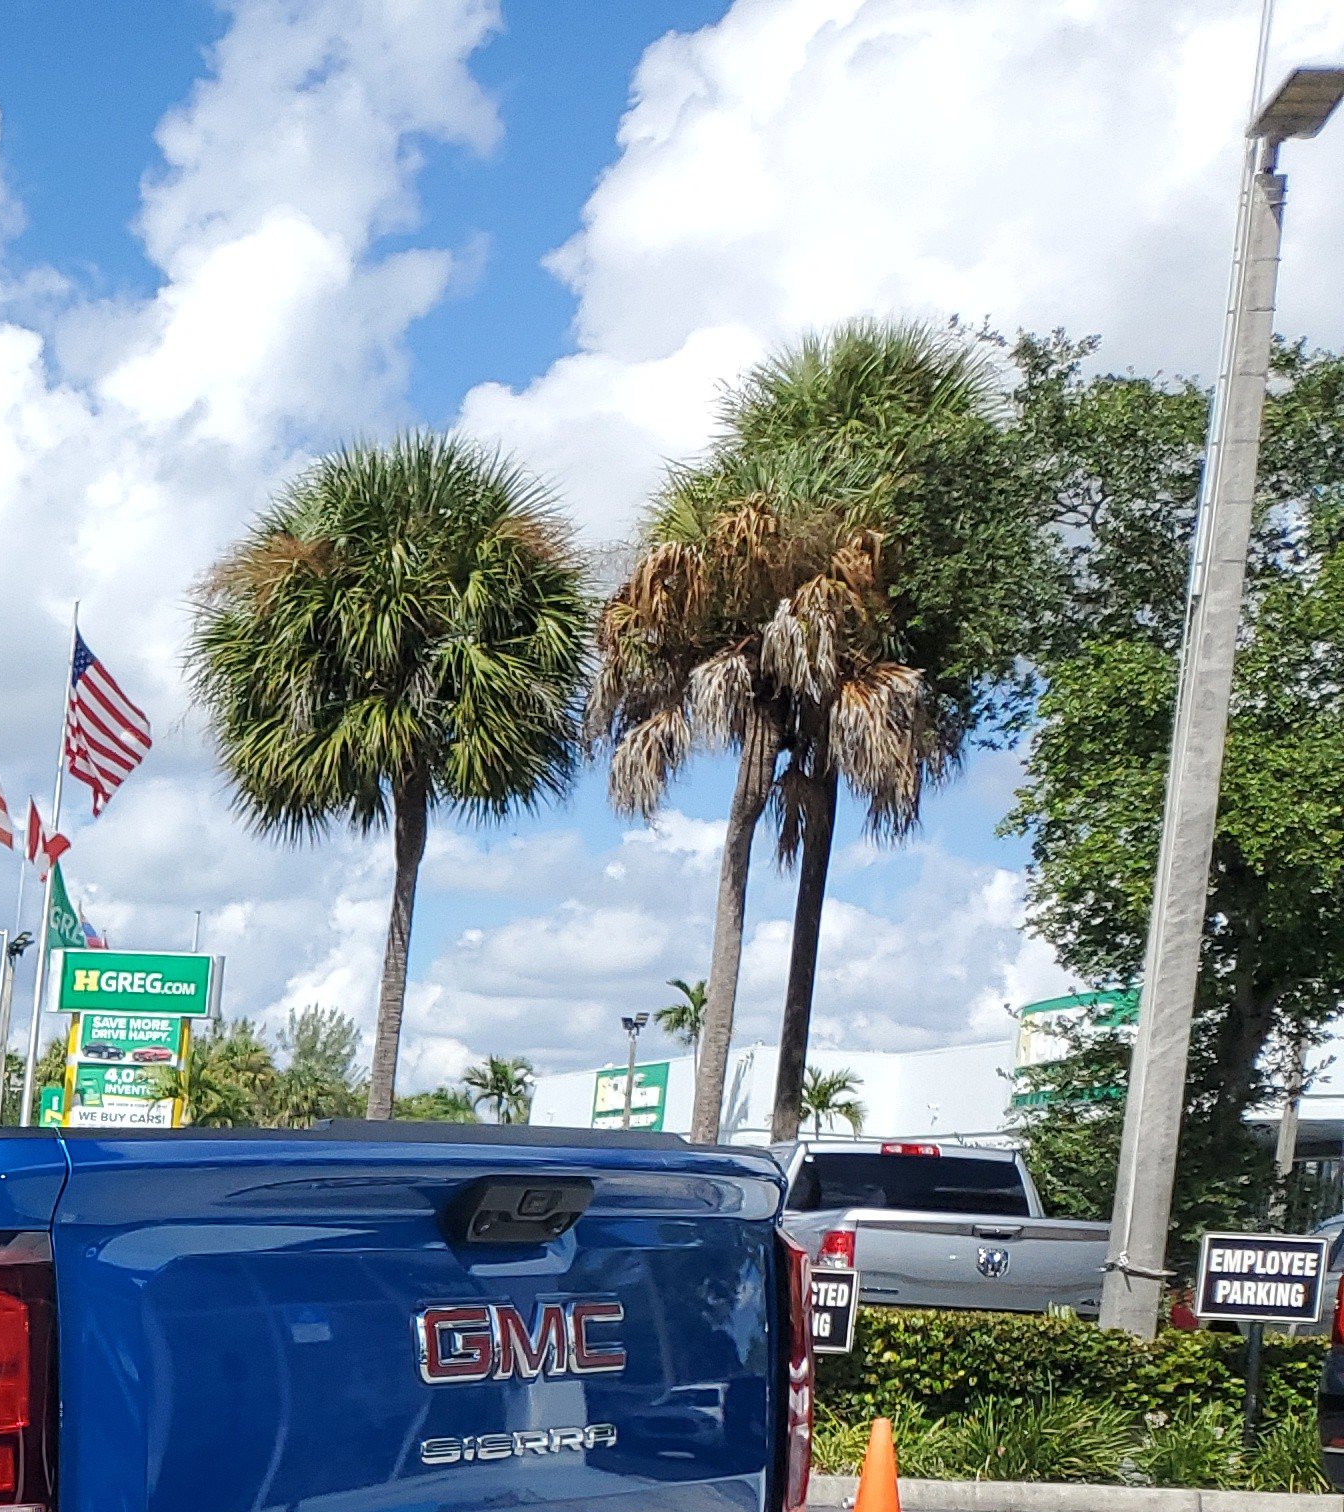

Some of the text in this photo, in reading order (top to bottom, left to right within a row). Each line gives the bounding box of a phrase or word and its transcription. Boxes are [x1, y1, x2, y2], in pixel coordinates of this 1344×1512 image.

[74, 970, 196, 995] HGREG.COM
[92, 1016, 174, 1031] SAVE MORE.
[92, 1028, 171, 1042] DRIVE HAPPY.
[79, 1111, 166, 1125] WE BUY CARS!
[1209, 1248, 1319, 1277] EMPLOYEE
[1215, 1279, 1306, 1308] PARKING
[415, 1302, 627, 1384] GMC
[421, 1423, 617, 1465] SIERRA
